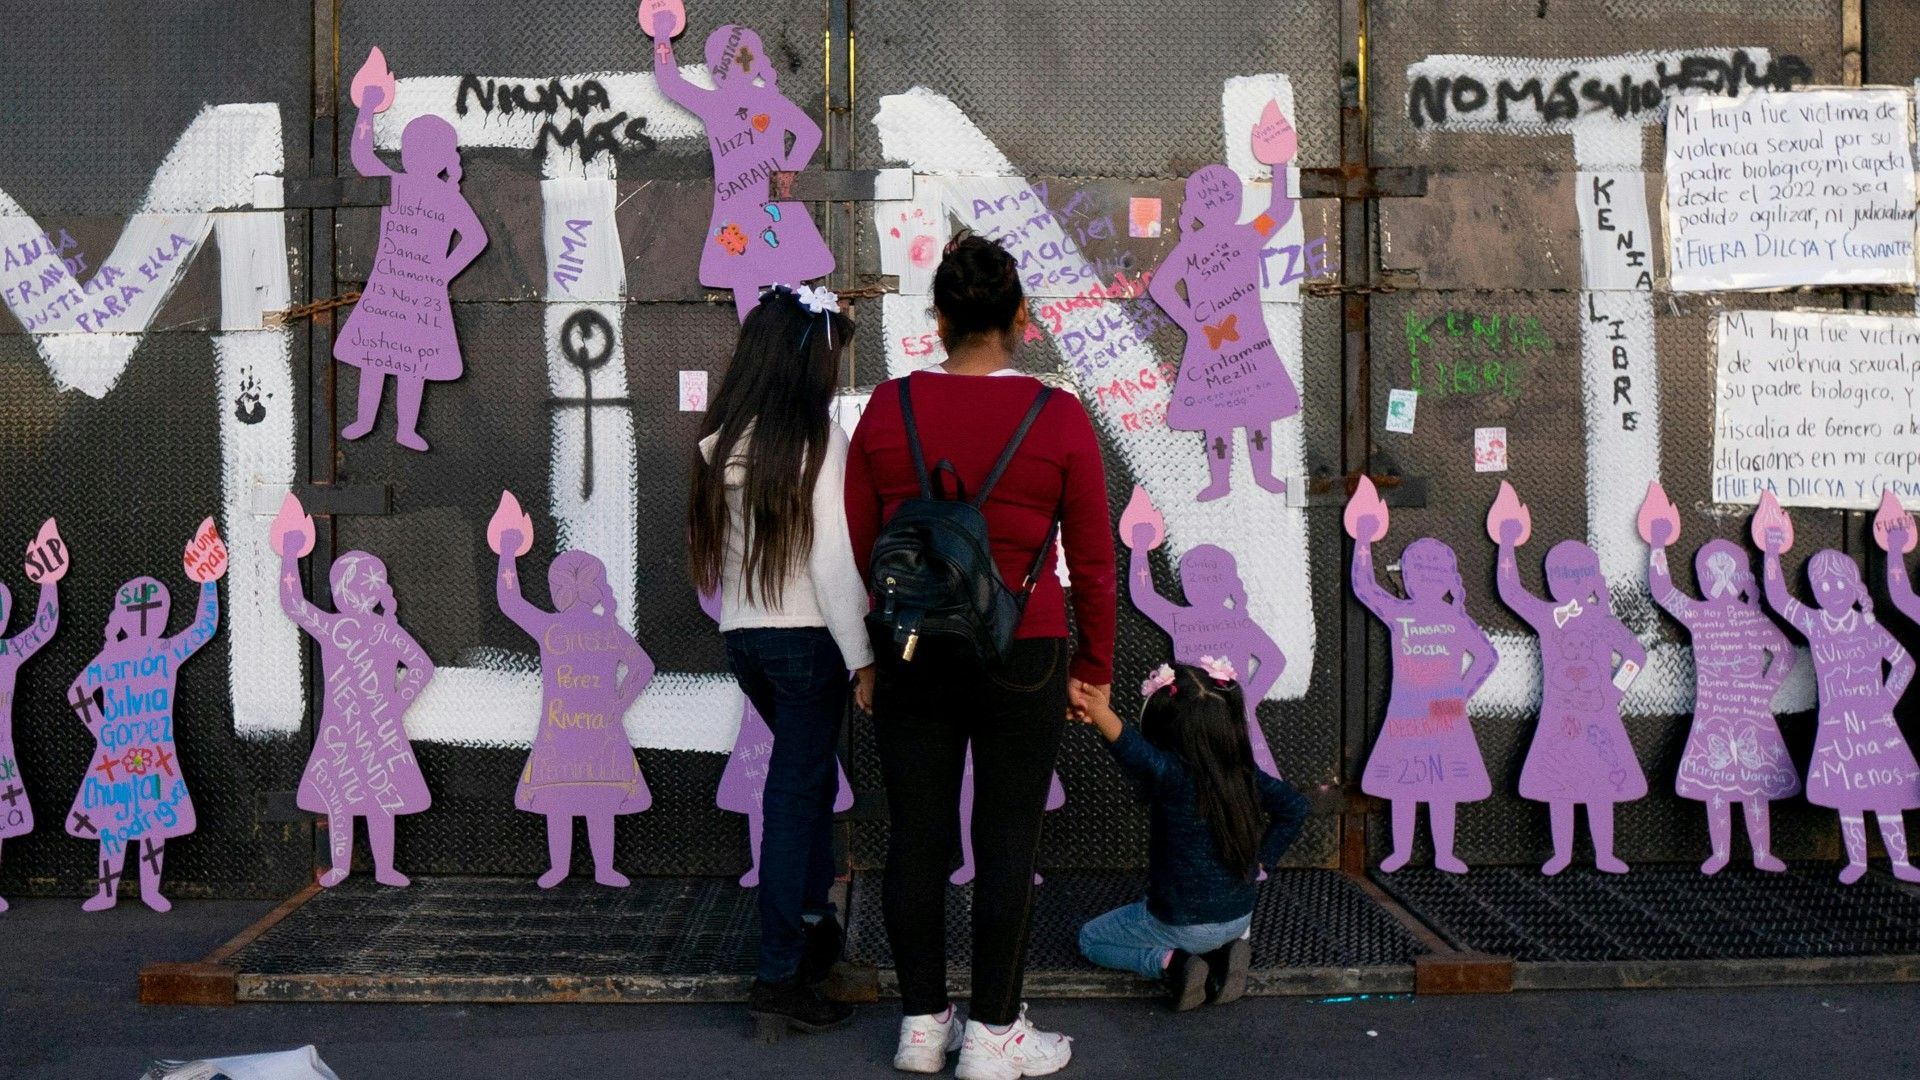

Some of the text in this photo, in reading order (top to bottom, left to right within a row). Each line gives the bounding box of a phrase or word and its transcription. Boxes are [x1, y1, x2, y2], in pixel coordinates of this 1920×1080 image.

[1408, 75, 1489, 127] NO
[1675, 104, 1698, 135] Mi
[1711, 103, 1752, 133] hija
[1761, 100, 1791, 124] fue
[1876, 100, 1897, 120] de
[1674, 129, 1891, 160] violencia sexual por su
[1680, 162, 1732, 188] padre
[1826, 159, 1849, 173] mi
[388, 185, 446, 223] Justicia
[1198, 181, 1229, 200] UNA
[1677, 186, 1732, 208] desde
[1739, 184, 1758, 204] el
[1769, 180, 1816, 200] 2022
[1823, 184, 1848, 198] no
[386, 220, 418, 237] para
[1593, 176, 1653, 289] KENIA
[1679, 208, 1738, 235] podido
[1825, 210, 1844, 224] ni
[383, 236, 431, 264] Danae
[1824, 238, 1838, 261] Y
[76, 233, 195, 333] PARA ELLA
[376, 258, 445, 288] Chamorro
[372, 281, 443, 312] 13 Nov 23
[1195, 282, 1256, 323] Claudia
[350, 327, 441, 363] Justicia por
[1725, 312, 1754, 339] Mi
[1770, 317, 1809, 353] hija
[1819, 317, 1849, 342] fue
[1727, 350, 1752, 374] de
[1768, 350, 1841, 375] violencia
[1723, 383, 1746, 400] su
[1751, 380, 1802, 406] padre
[1719, 407, 1790, 440] fiscalia
[1796, 417, 1816, 437] de
[1811, 453, 1836, 467] en
[1844, 453, 1866, 466] mi
[1855, 479, 1865, 499] Y
[25, 537, 66, 581] SLP
[1844, 709, 1867, 735] Ni
[1833, 736, 1879, 761] Una
[1822, 760, 1903, 791] Menos
